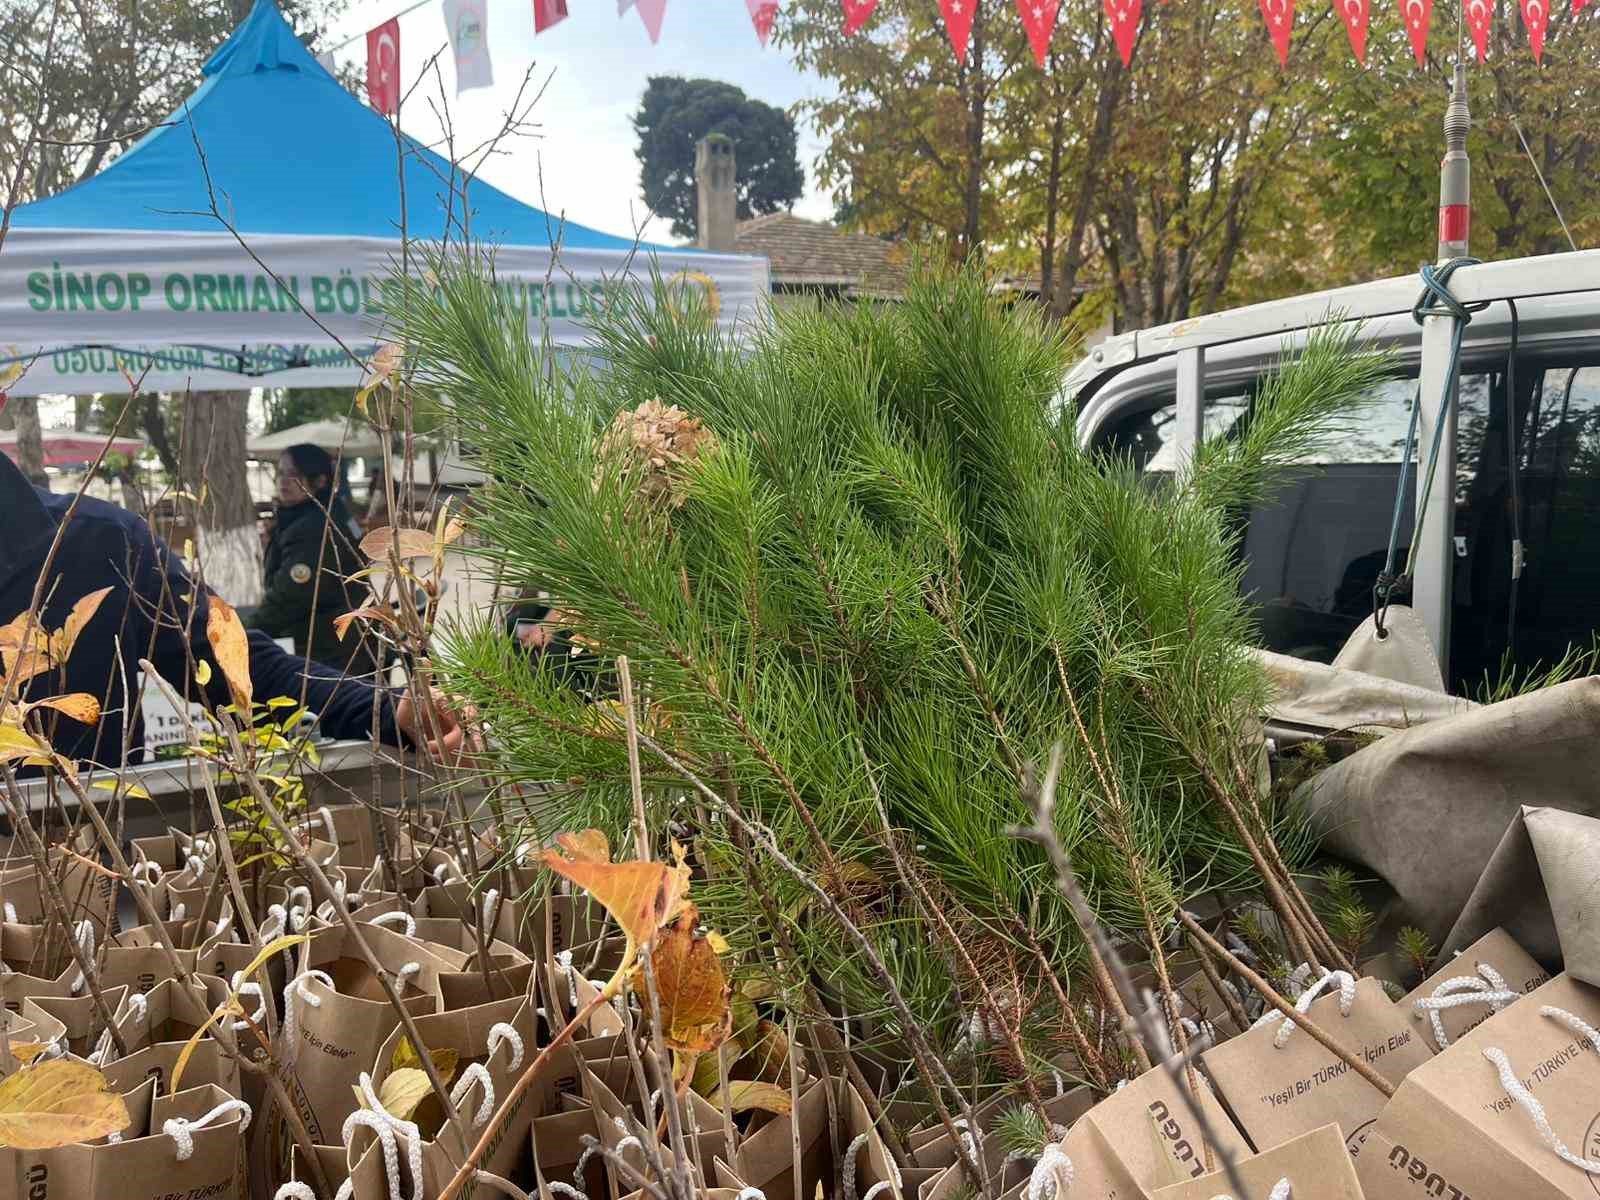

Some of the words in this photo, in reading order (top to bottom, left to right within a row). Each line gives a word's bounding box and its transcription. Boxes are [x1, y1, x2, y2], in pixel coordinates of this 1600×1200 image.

[26, 261, 152, 312] SİNOP
[164, 273, 301, 313] ORMAN
[1296, 1080, 1312, 1096] Bir
[1365, 1046, 1386, 1063] İçin
[1532, 1043, 1579, 1083] TÜRKİYE
